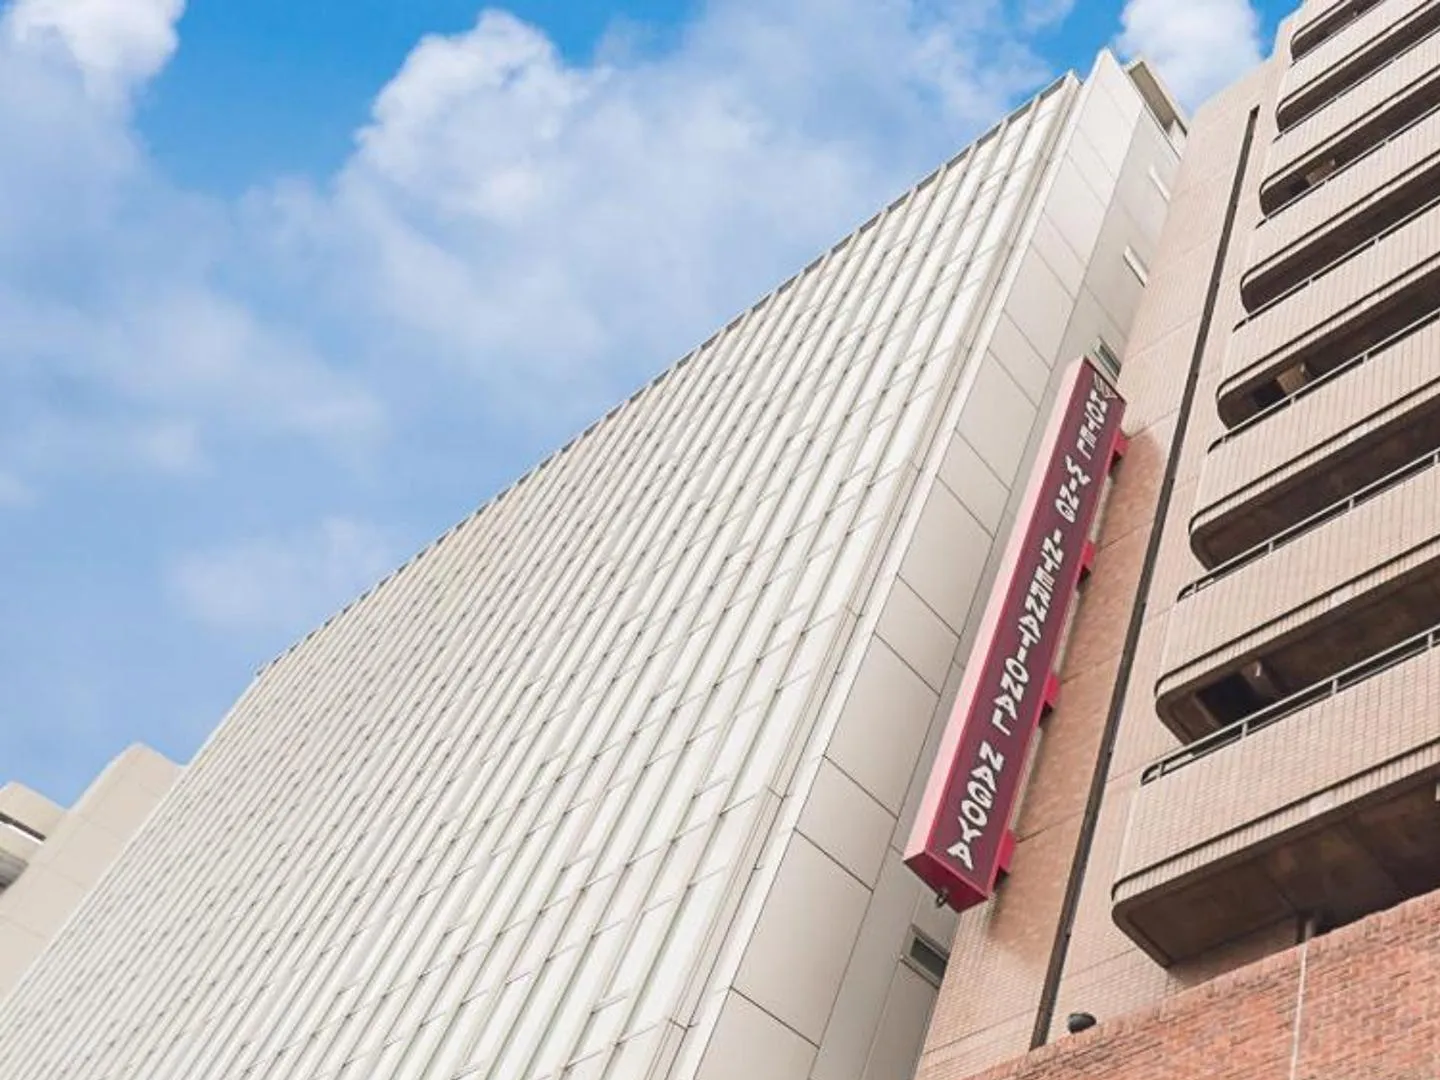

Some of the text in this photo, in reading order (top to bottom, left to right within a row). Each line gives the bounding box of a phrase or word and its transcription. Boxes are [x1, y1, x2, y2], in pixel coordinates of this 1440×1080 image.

[947, 388, 1108, 869] HOTEL WING INTERNATIONAL NAGOYA
